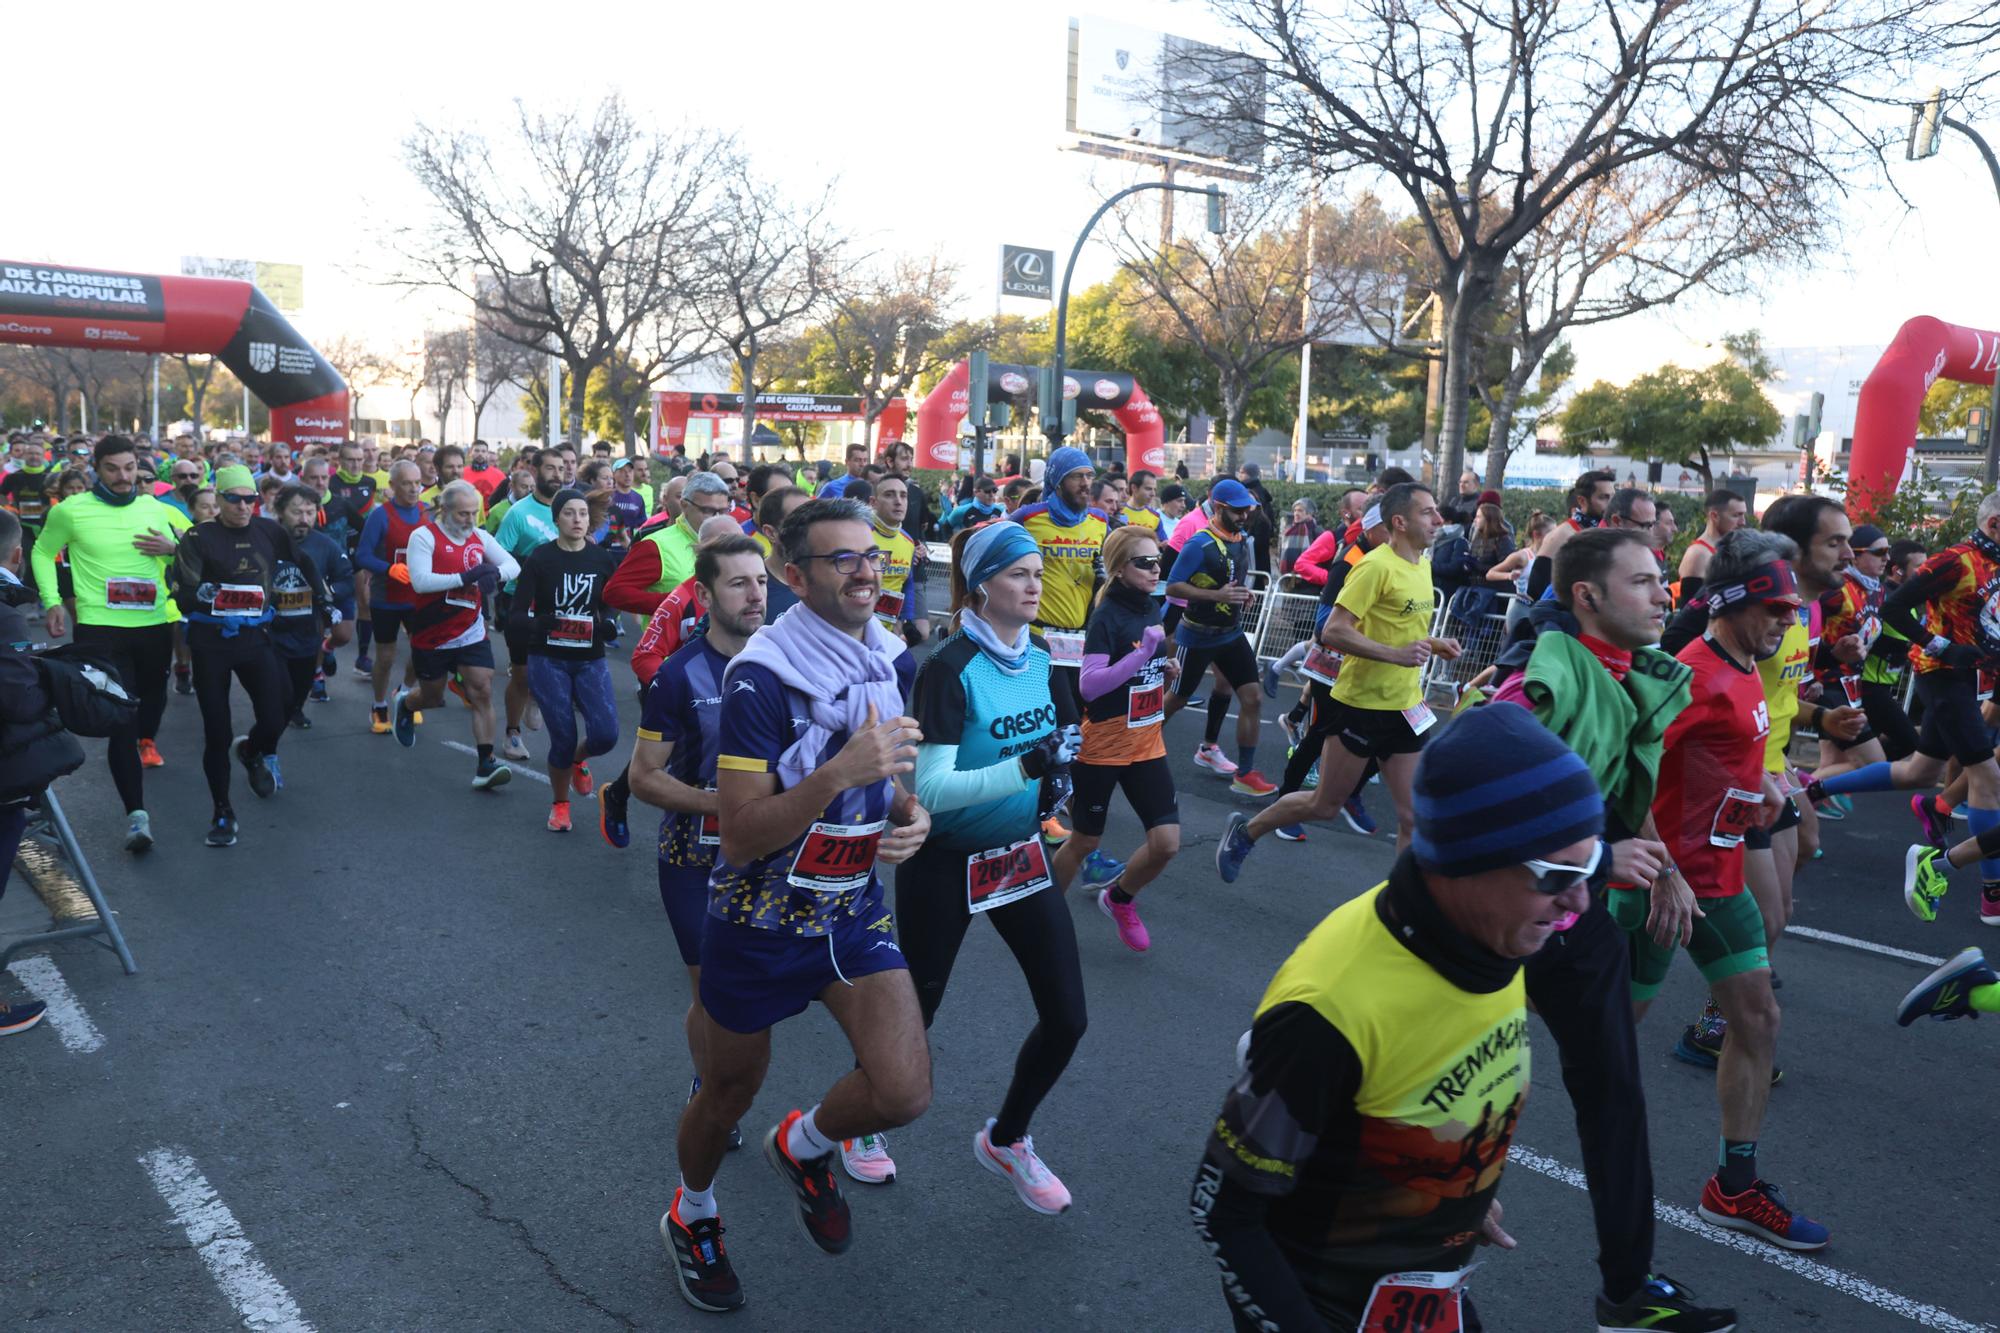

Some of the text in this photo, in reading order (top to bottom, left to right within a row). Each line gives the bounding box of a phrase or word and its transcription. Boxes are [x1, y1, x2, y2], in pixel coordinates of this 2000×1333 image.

[4, 267, 143, 290] DE CARRERES
[1006, 281, 1050, 293] LEXUS
[53, 284, 147, 304] POPULAR
[555, 573, 597, 608] JUST
[990, 704, 1056, 740] CRESPO
[815, 838, 869, 866] 2713
